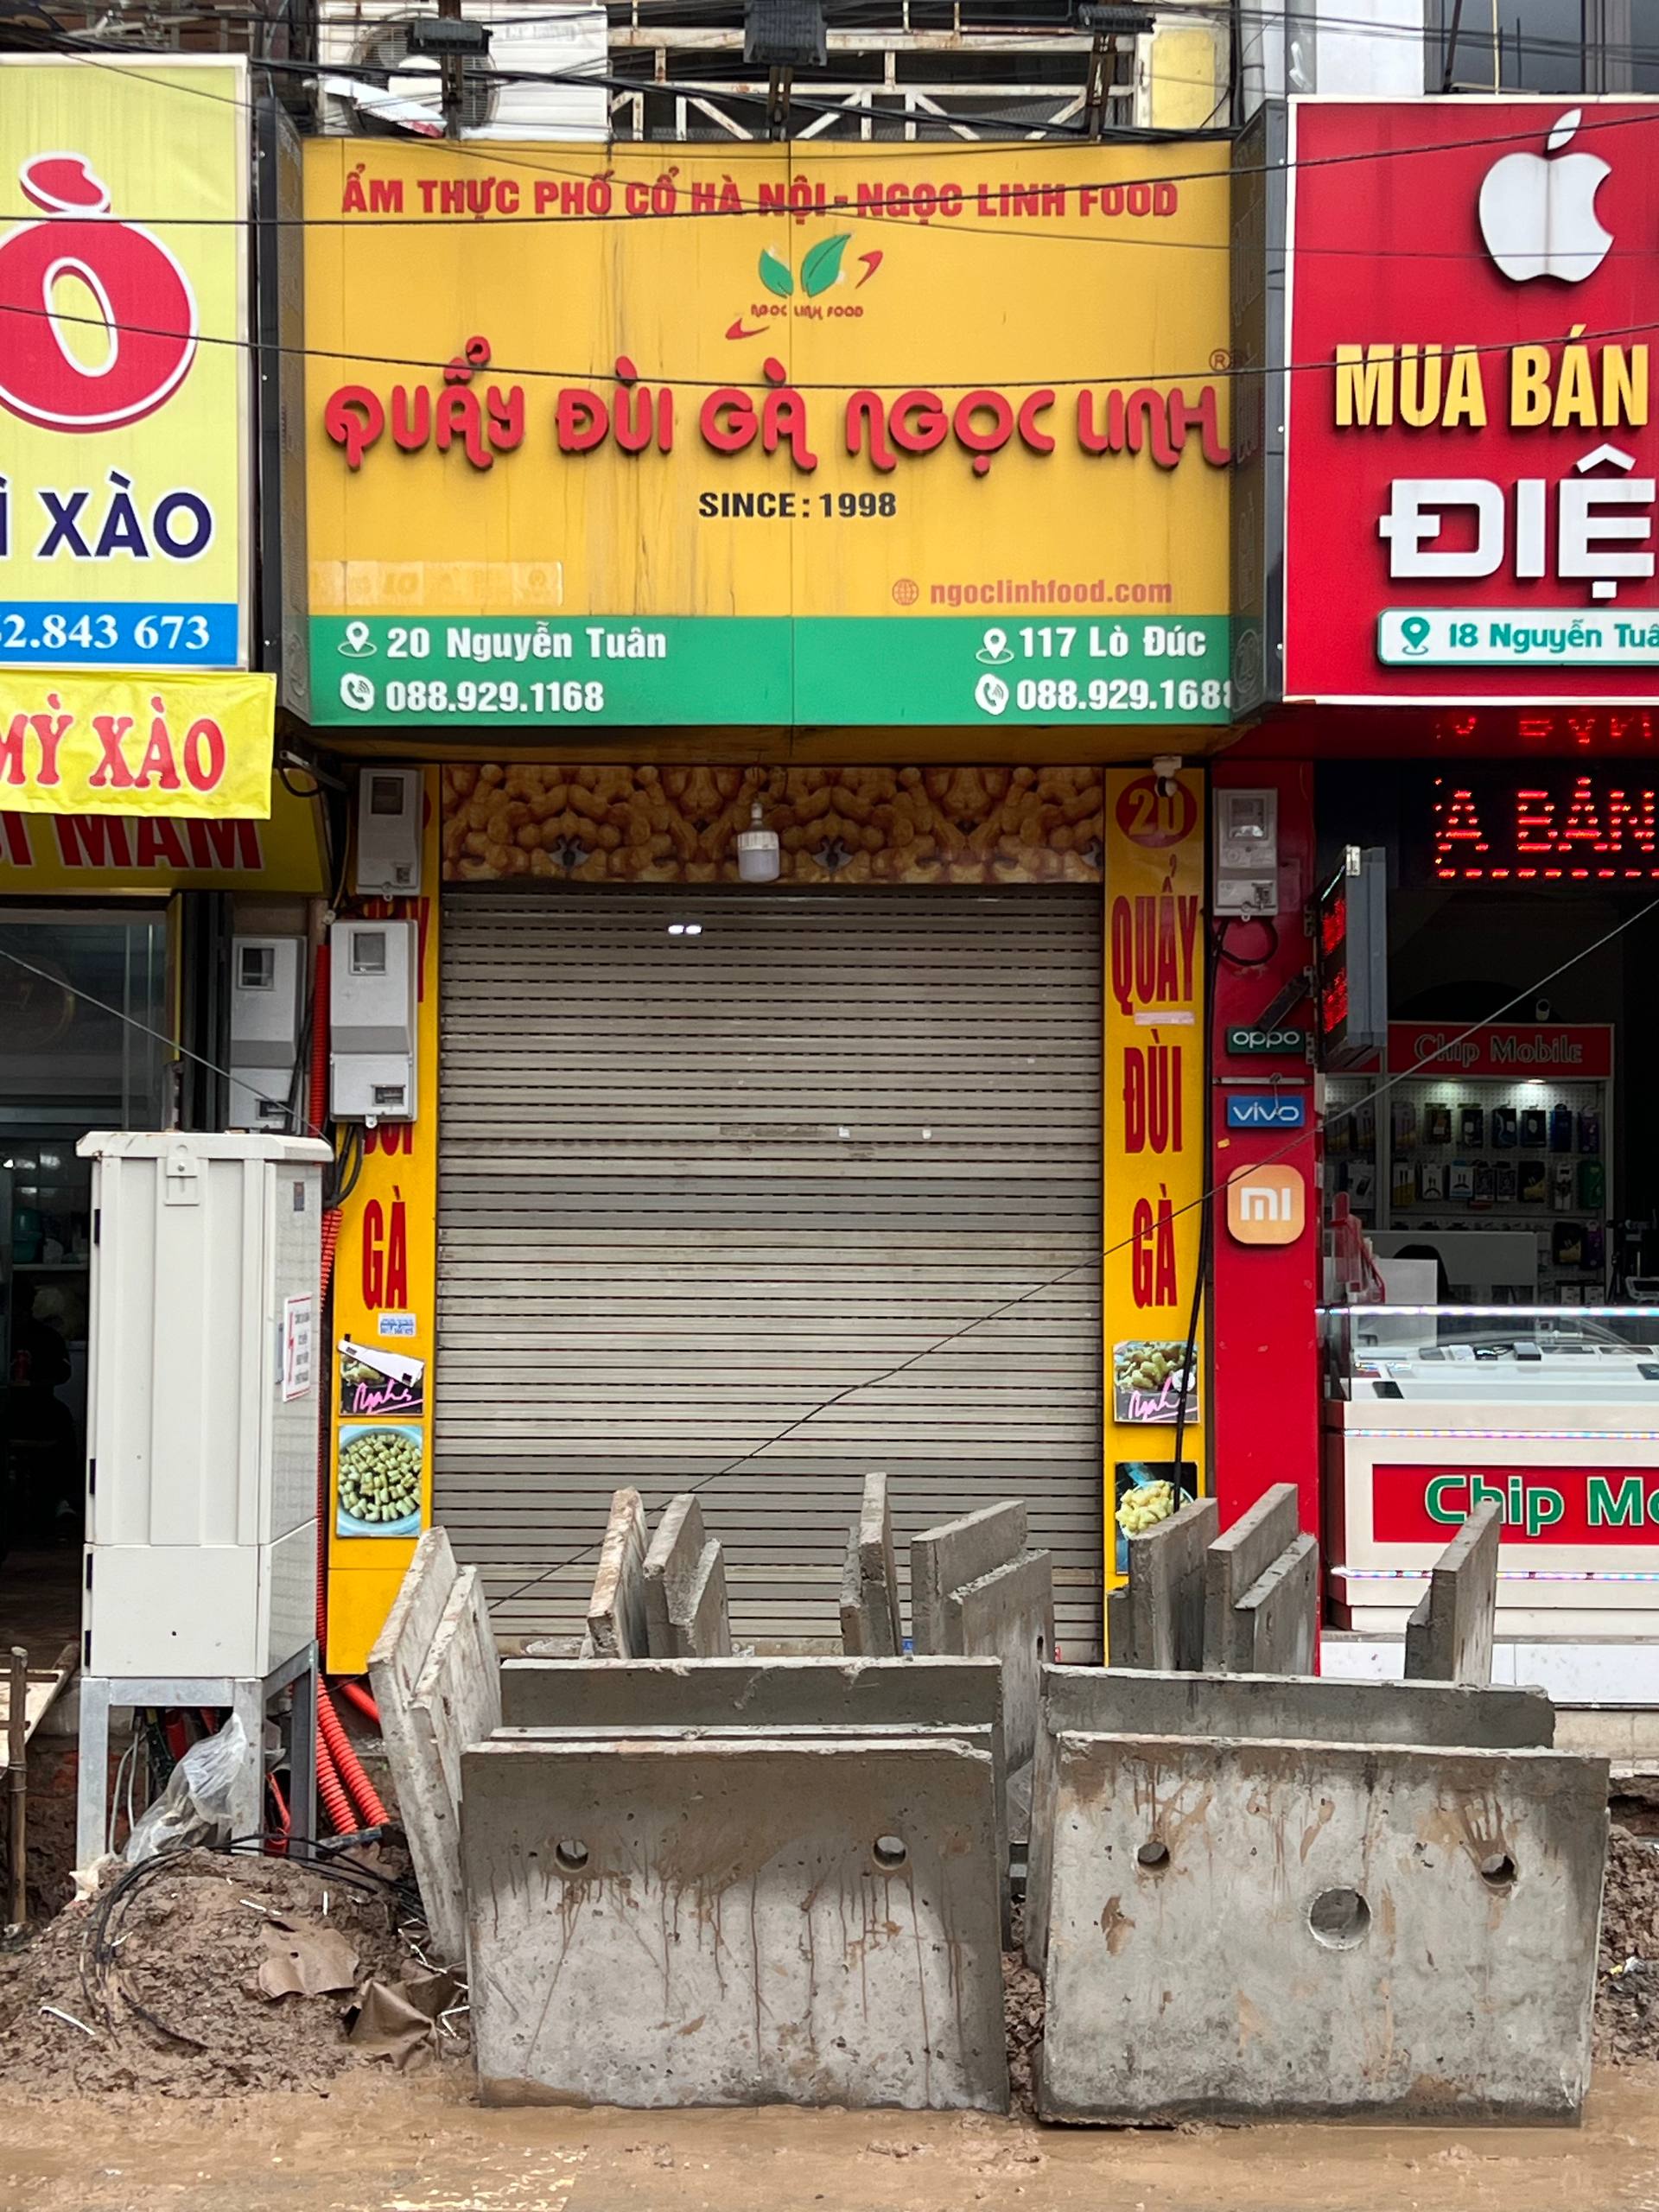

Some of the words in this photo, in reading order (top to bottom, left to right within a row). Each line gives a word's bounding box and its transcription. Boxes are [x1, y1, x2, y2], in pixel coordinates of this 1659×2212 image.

[342, 162, 403, 213] ẨM
[416, 176, 520, 220] THỰC
[534, 169, 615, 215] PHỐ
[625, 165, 681, 216] CỔ
[693, 175, 743, 215] HÀ
[977, 182, 1066, 217] LINH
[1079, 182, 1179, 217] FOOD
[1335, 342, 1488, 428] MUA
[1510, 322, 1649, 428] BÁN
[323, 335, 524, 471] QUẨY
[555, 355, 674, 455] ĐÙI
[699, 357, 817, 472] GÀ
[845, 389, 1056, 477] NGỌC
[36, 469, 214, 560] XÀO
[818, 492, 898, 518] 1998
[1378, 442, 1656, 599] ĐIỆ
[930, 580, 1174, 607] ngoclinhfood.com
[0, 613, 120, 651] 2.843
[134, 614, 211, 651] 673
[386, 626, 430, 659] 20
[446, 620, 573, 663] Nguyễn
[585, 626, 667, 659] Tuân
[1018, 626, 1077, 658] 117
[1089, 625, 1129, 658] Lò
[1142, 624, 1208, 658] Đúc
[1449, 623, 1479, 648] 18
[1490, 619, 1603, 654] Nguyễn
[385, 680, 605, 713] 088.929.1168
[89, 695, 226, 793] XÀO
[1128, 787, 1186, 836] 20
[1414, 1033, 1481, 1068] Chip
[1490, 1033, 1584, 1065] Mobile
[1122, 1028, 1183, 1154] ĐÙI
[362, 1185, 408, 1310] GÀ
[1132, 1183, 1178, 1310] GÀ
[1424, 1473, 1565, 1537] Chip
